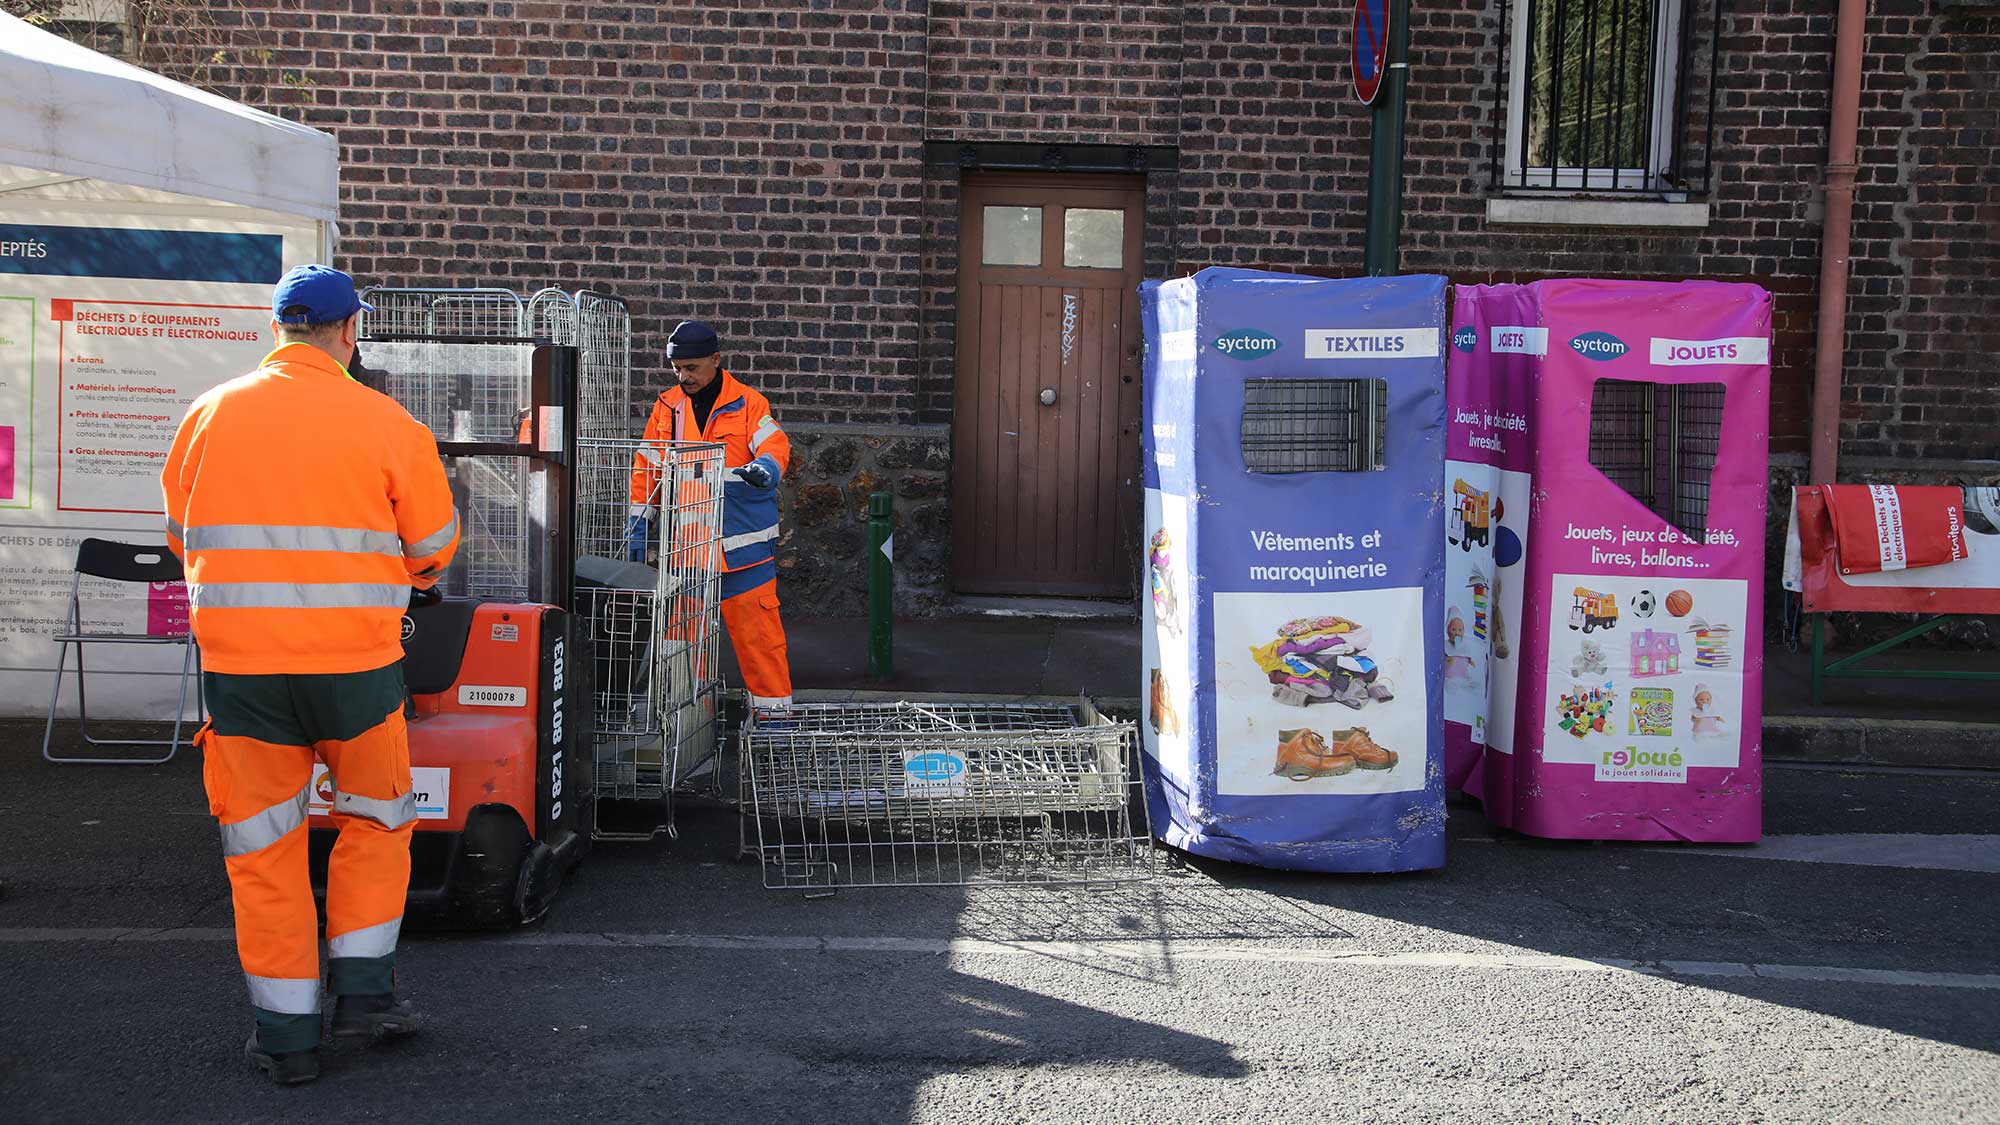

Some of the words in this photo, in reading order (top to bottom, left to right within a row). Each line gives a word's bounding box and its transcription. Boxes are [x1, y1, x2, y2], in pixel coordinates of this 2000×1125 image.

[1, 238, 47, 258] EPTÉS
[77, 310, 125, 323] DÉCHETS
[129, 312, 220, 327] D'ÉQUIPEMENTS
[77, 323, 148, 336] ÉLECTRIQUES
[152, 328, 164, 337] ET
[168, 327, 258, 341] ÉLECTRONIQUES
[1217, 336, 1277, 354] syctom
[1325, 336, 1405, 352] TEXTILES
[1573, 337, 1625, 354] syctom
[1667, 343, 1737, 360] JOUETS
[77, 355, 104, 364] Écrans
[76, 384, 115, 393] Matériels
[118, 385, 176, 395] informatiques
[76, 410, 99, 419] Petits
[101, 411, 170, 423] électroménagers
[98, 447, 167, 459] électroménagers
[1889, 497, 1897, 507] et
[1879, 506, 1890, 544] Déchets
[39, 538, 53, 546] DE
[1251, 529, 1355, 552] Vêtements
[1361, 529, 1382, 548] et
[1563, 523, 1617, 543] Jouets,
[1621, 525, 1654, 546] jeux
[1657, 526, 1679, 544] de
[1682, 528, 1740, 547] siété,
[1890, 509, 1904, 561] électriques
[1591, 546, 1636, 568] livres,
[1641, 548, 1711, 568] ballons...
[1884, 547, 1892, 562] Les
[1250, 558, 1388, 587] maroquinerie
[553, 641, 564, 692] 803
[469, 691, 515, 702] 21000078
[553, 697, 563, 745] 801
[552, 751, 562, 799] 821
[1601, 768, 1610, 776] le
[1612, 768, 1637, 778] jouet
[1641, 769, 1681, 777] solidaire
[552, 801, 562, 820] 0
